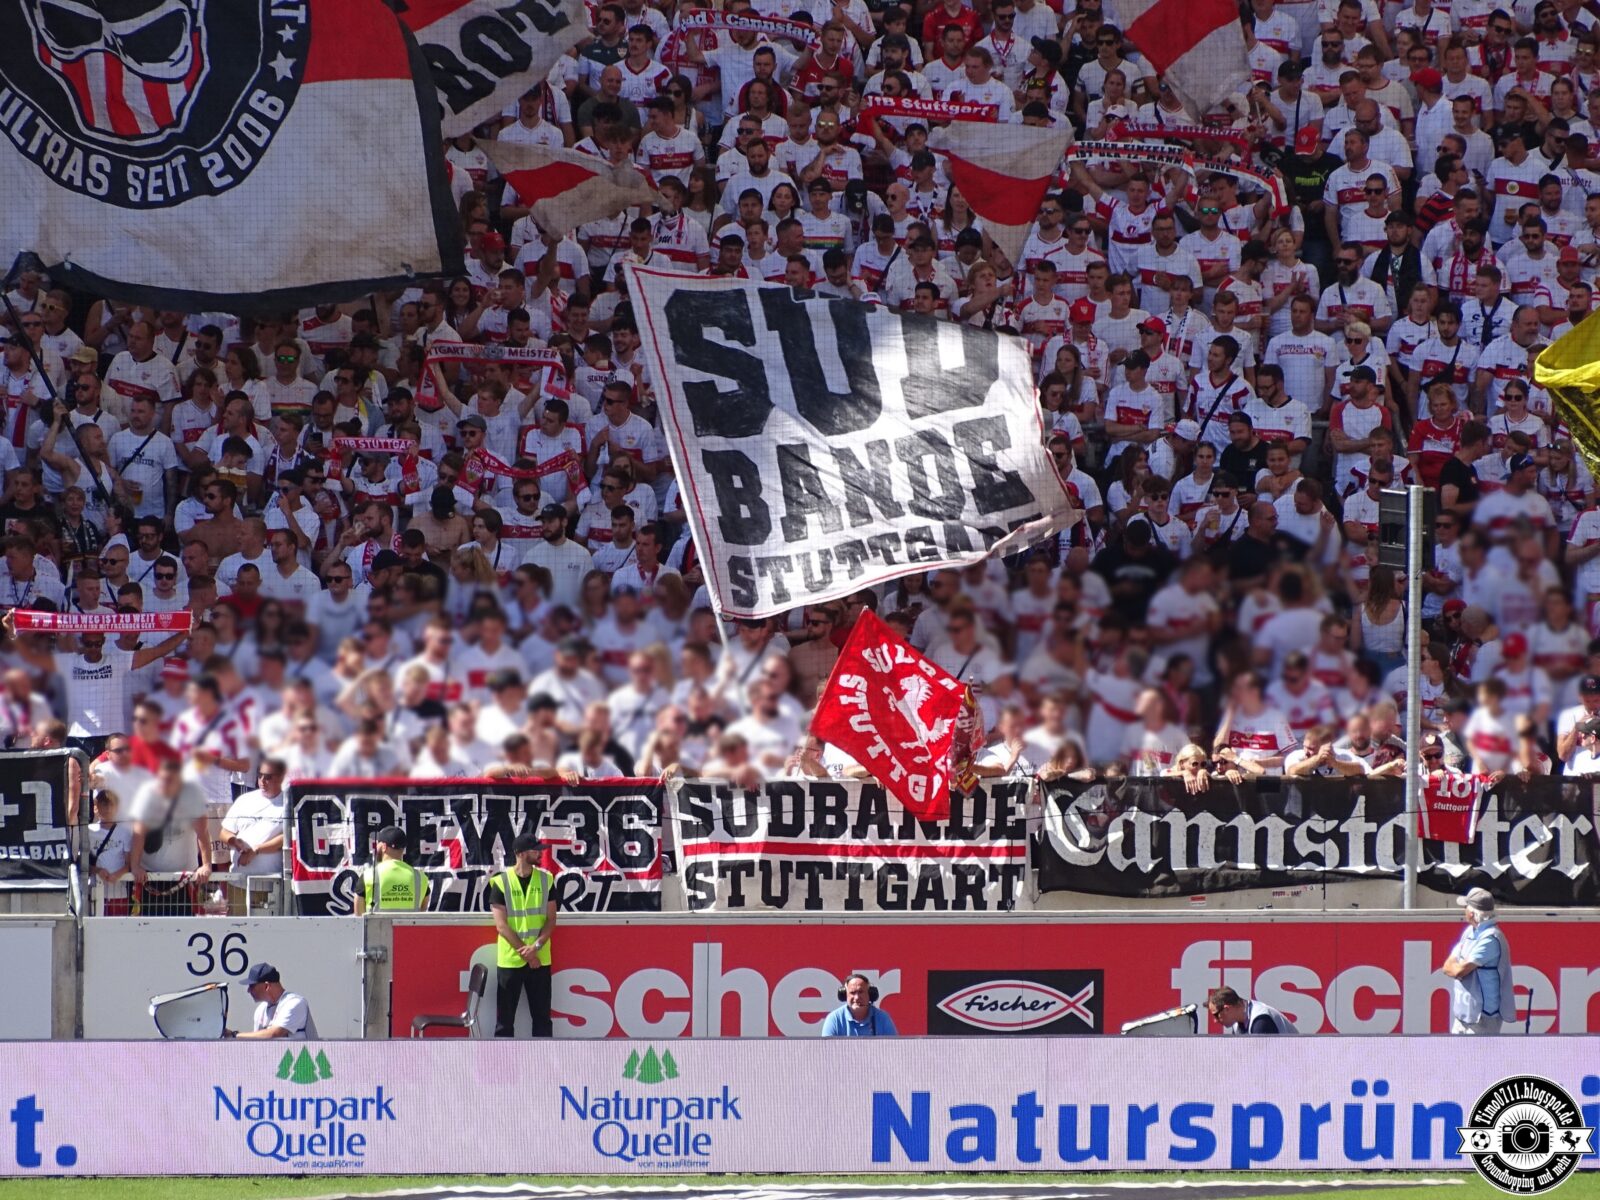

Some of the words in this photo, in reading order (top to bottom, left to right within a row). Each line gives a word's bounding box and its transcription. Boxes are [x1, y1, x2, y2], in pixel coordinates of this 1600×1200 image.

[901, 97, 990, 116] Stuttgart
[126, 154, 190, 202] SEIT
[200, 88, 286, 188] 2006
[1076, 150, 1093, 159] IST
[1099, 151, 1121, 159] DER
[1146, 154, 1184, 165] MANN
[1079, 141, 1119, 151] JEDER
[507, 348, 558, 359] MEISTER
[701, 413, 1036, 547] BANDE
[57, 613, 79, 625] KEIN
[80, 613, 100, 625] WEG
[102, 613, 117, 625] IST
[120, 613, 131, 624] ZU
[133, 613, 156, 624] WEIT
[391, 884, 409, 892] SDS
[684, 860, 1026, 912] STUTTGART
[186, 932, 249, 977] 36
[965, 994, 1057, 1012] fischer
[213, 1085, 397, 1129] Naturpark
[560, 1085, 743, 1129] Naturpark
[246, 1120, 367, 1163] Quelle
[592, 1120, 712, 1162] Quelle
